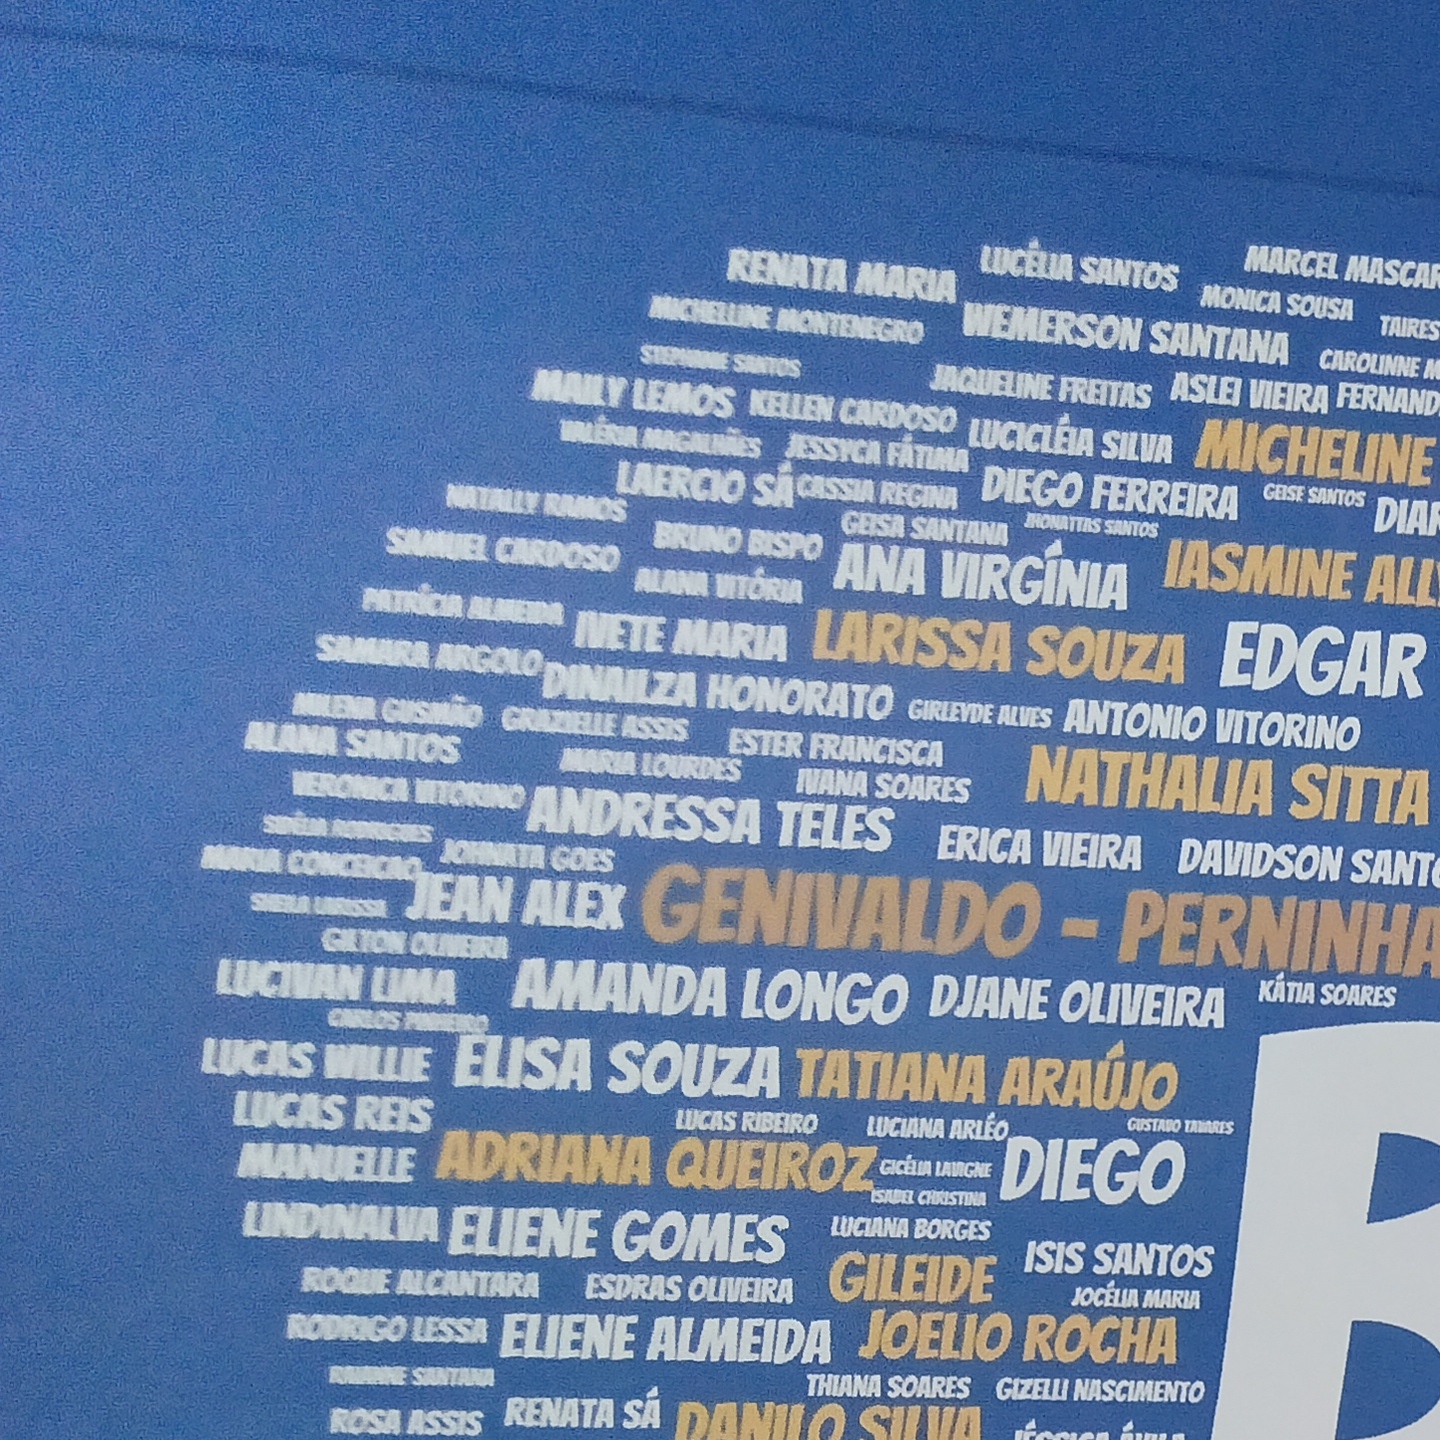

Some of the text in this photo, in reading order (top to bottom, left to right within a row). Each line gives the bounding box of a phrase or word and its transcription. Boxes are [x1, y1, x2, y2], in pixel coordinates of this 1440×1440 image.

[1244, 245, 1338, 279] MARCEL
[963, 301, 1288, 365] WEMERSON SANTANA
[1194, 419, 1436, 486] MICHELINE
[1164, 539, 1357, 600] IASMINE
[813, 609, 1184, 684] LARISSA SOUZA
[1220, 622, 1427, 698] EDGAR
[1026, 745, 1429, 825] NATHALIA SITTA
[642, 863, 1041, 958] GENIVALDO
[455, 1033, 780, 1098] ELISA SOUZA
[797, 1040, 1178, 1111] TATIANA ARAÚJO
[435, 1130, 879, 1195] ADRIANA QUEIROZ
[1000, 1136, 1185, 1204] DIEGO
[859, 1309, 1176, 1364] JOELIO ROCHA
